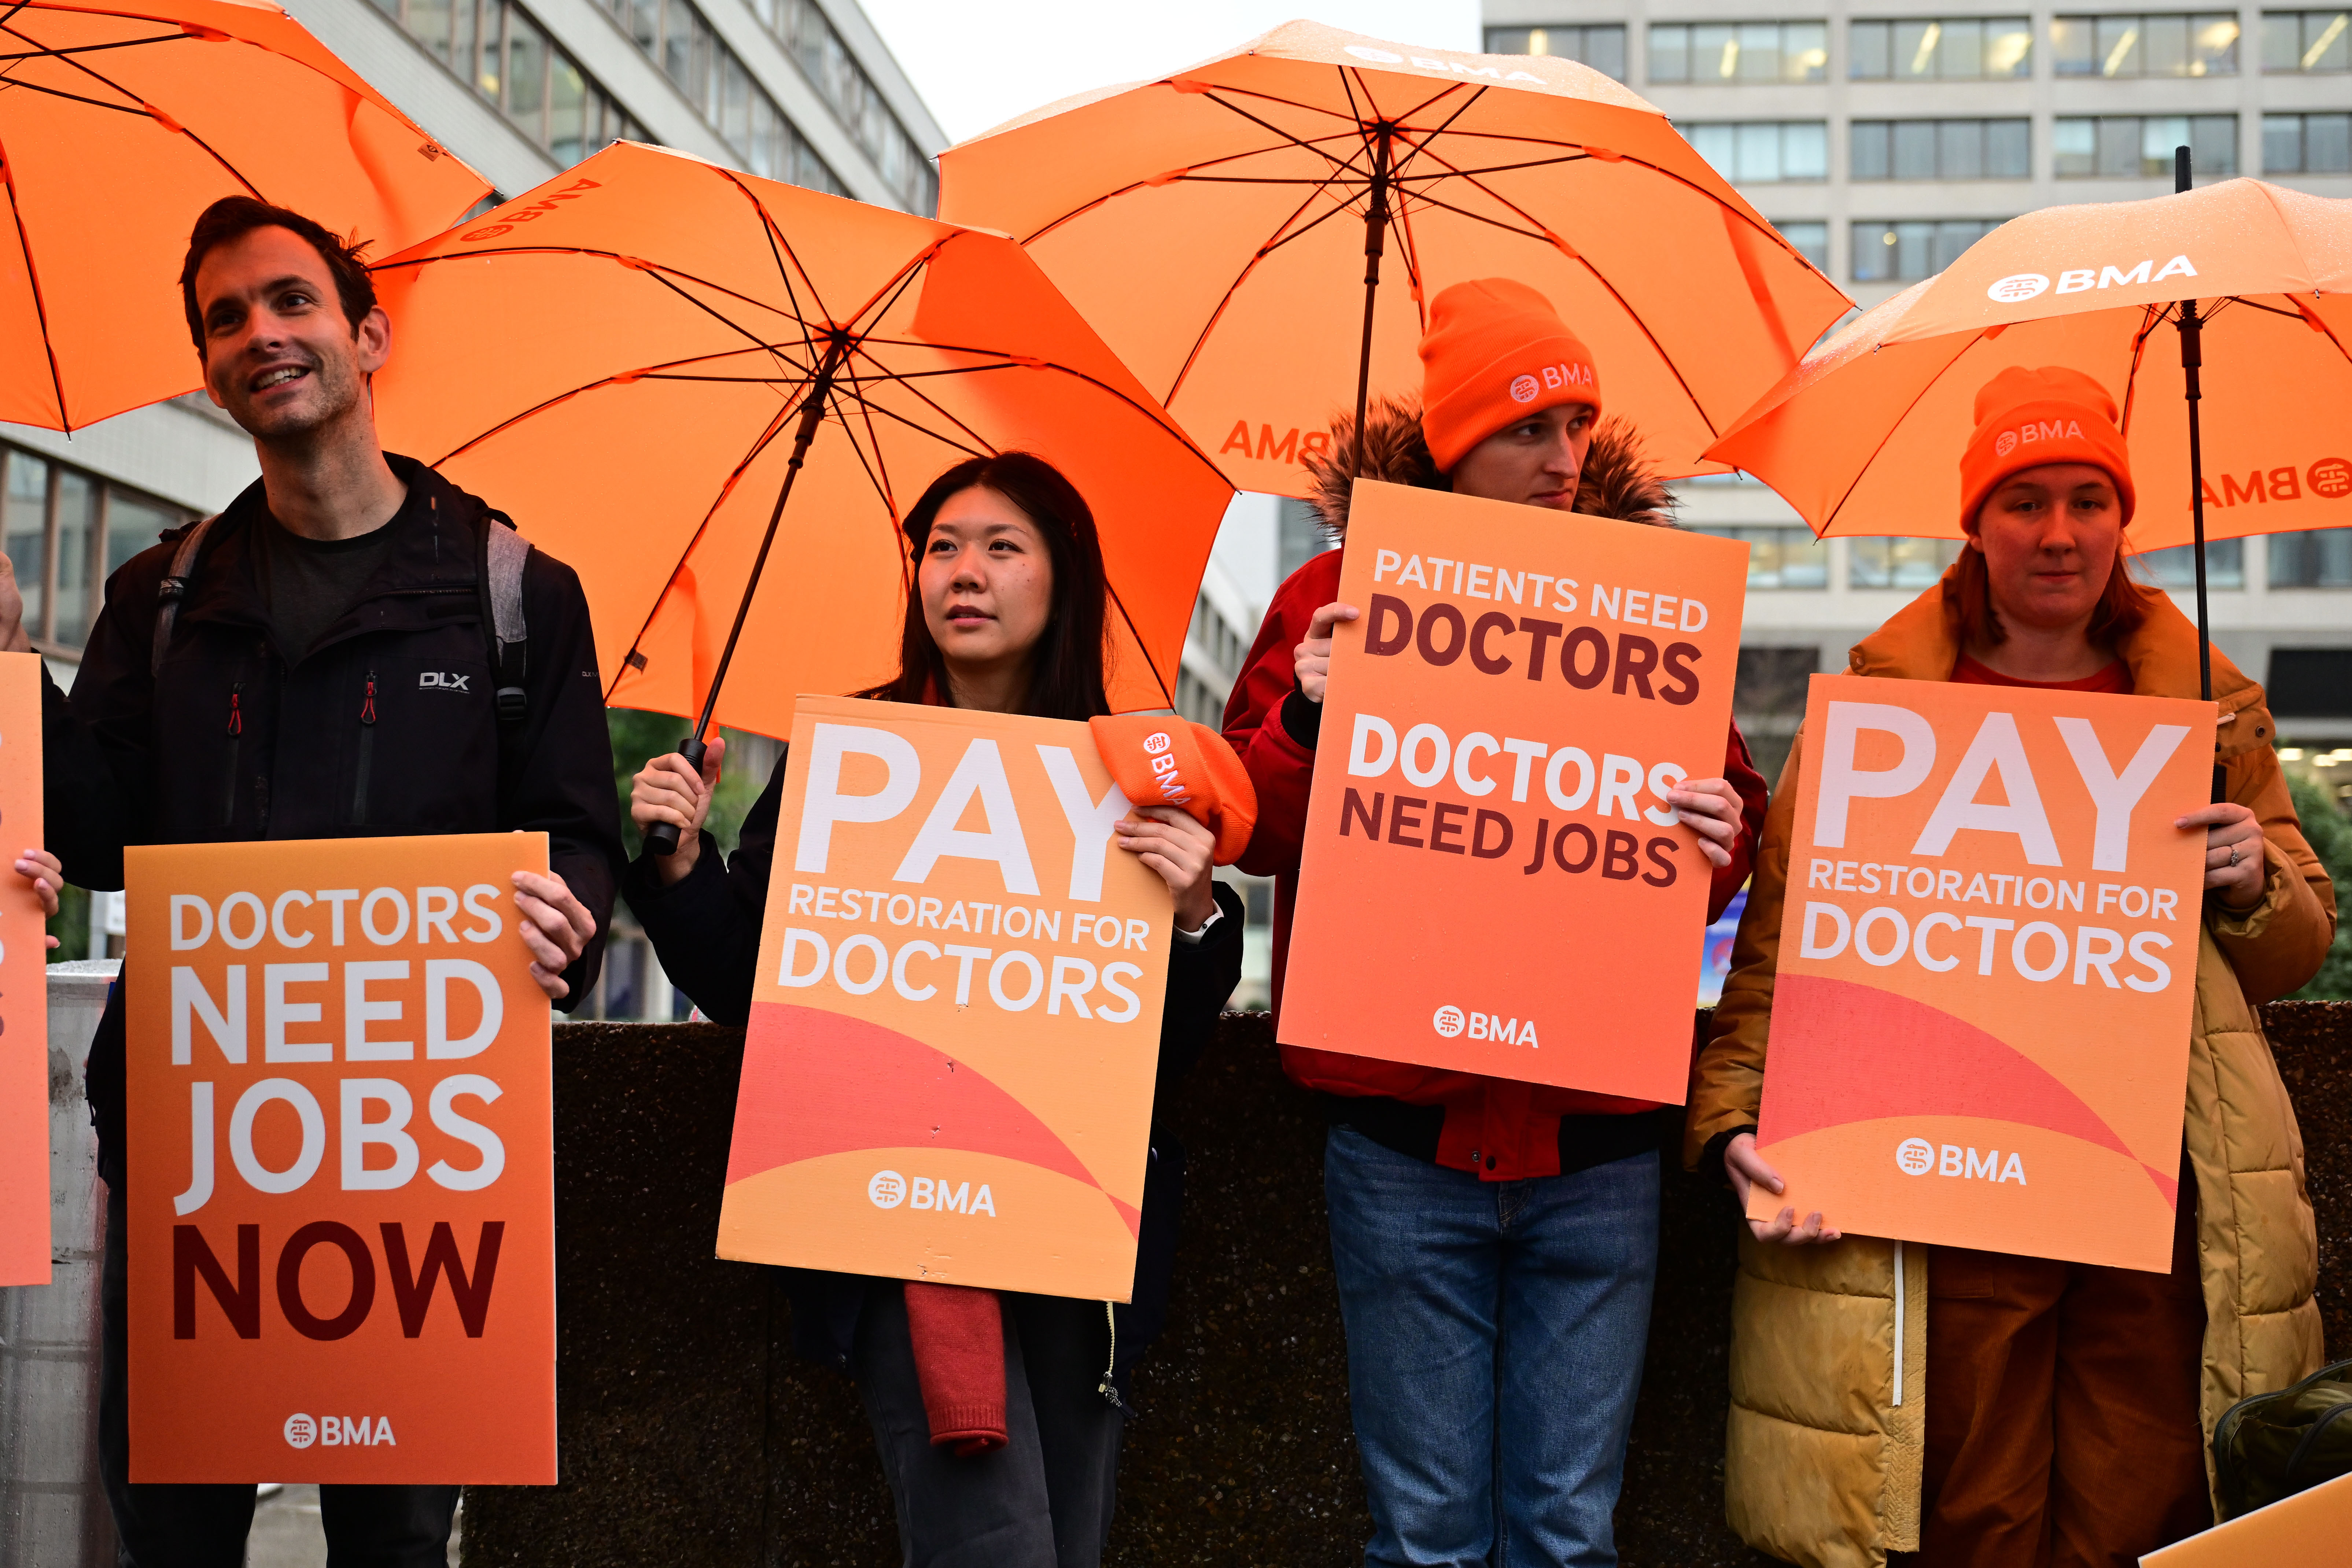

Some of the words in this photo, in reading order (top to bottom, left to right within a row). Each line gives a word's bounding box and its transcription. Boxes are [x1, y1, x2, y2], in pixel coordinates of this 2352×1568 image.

[1410, 56, 1547, 85] BMA
[2055, 255, 2198, 294] BMA
[1542, 363, 1593, 390] BMA
[2021, 420, 2085, 444] BMA
[1374, 549, 1578, 612] PATIENTS
[1590, 584, 1708, 632] NEED
[419, 672, 471, 690] DLX
[1364, 593, 1702, 705] DOCTORS
[1151, 753, 1191, 805] BMA
[1348, 713, 1688, 827] DOCTORS
[1813, 701, 2191, 872] PAY
[794, 722, 1131, 903] PAY
[1339, 787, 1513, 859] NEED
[1524, 818, 1680, 888] JOBS
[171, 884, 502, 951] DOCTORS
[788, 883, 1062, 941] RESTORATION
[1071, 913, 1150, 951] FOR
[1808, 859, 2085, 912] RESTORATION
[2097, 883, 2178, 921] FOR
[777, 927, 1144, 1023] DOCTORS
[1800, 901, 2173, 993] DOCTORS
[172, 959, 503, 1065] NEED
[1468, 1012, 1538, 1048] BMA
[174, 1074, 505, 1216] JOBS
[1939, 1144, 2027, 1185] BMA
[910, 1176, 996, 1217] BMA
[173, 1220, 505, 1341] NOW
[321, 1416, 396, 1446] BMA
